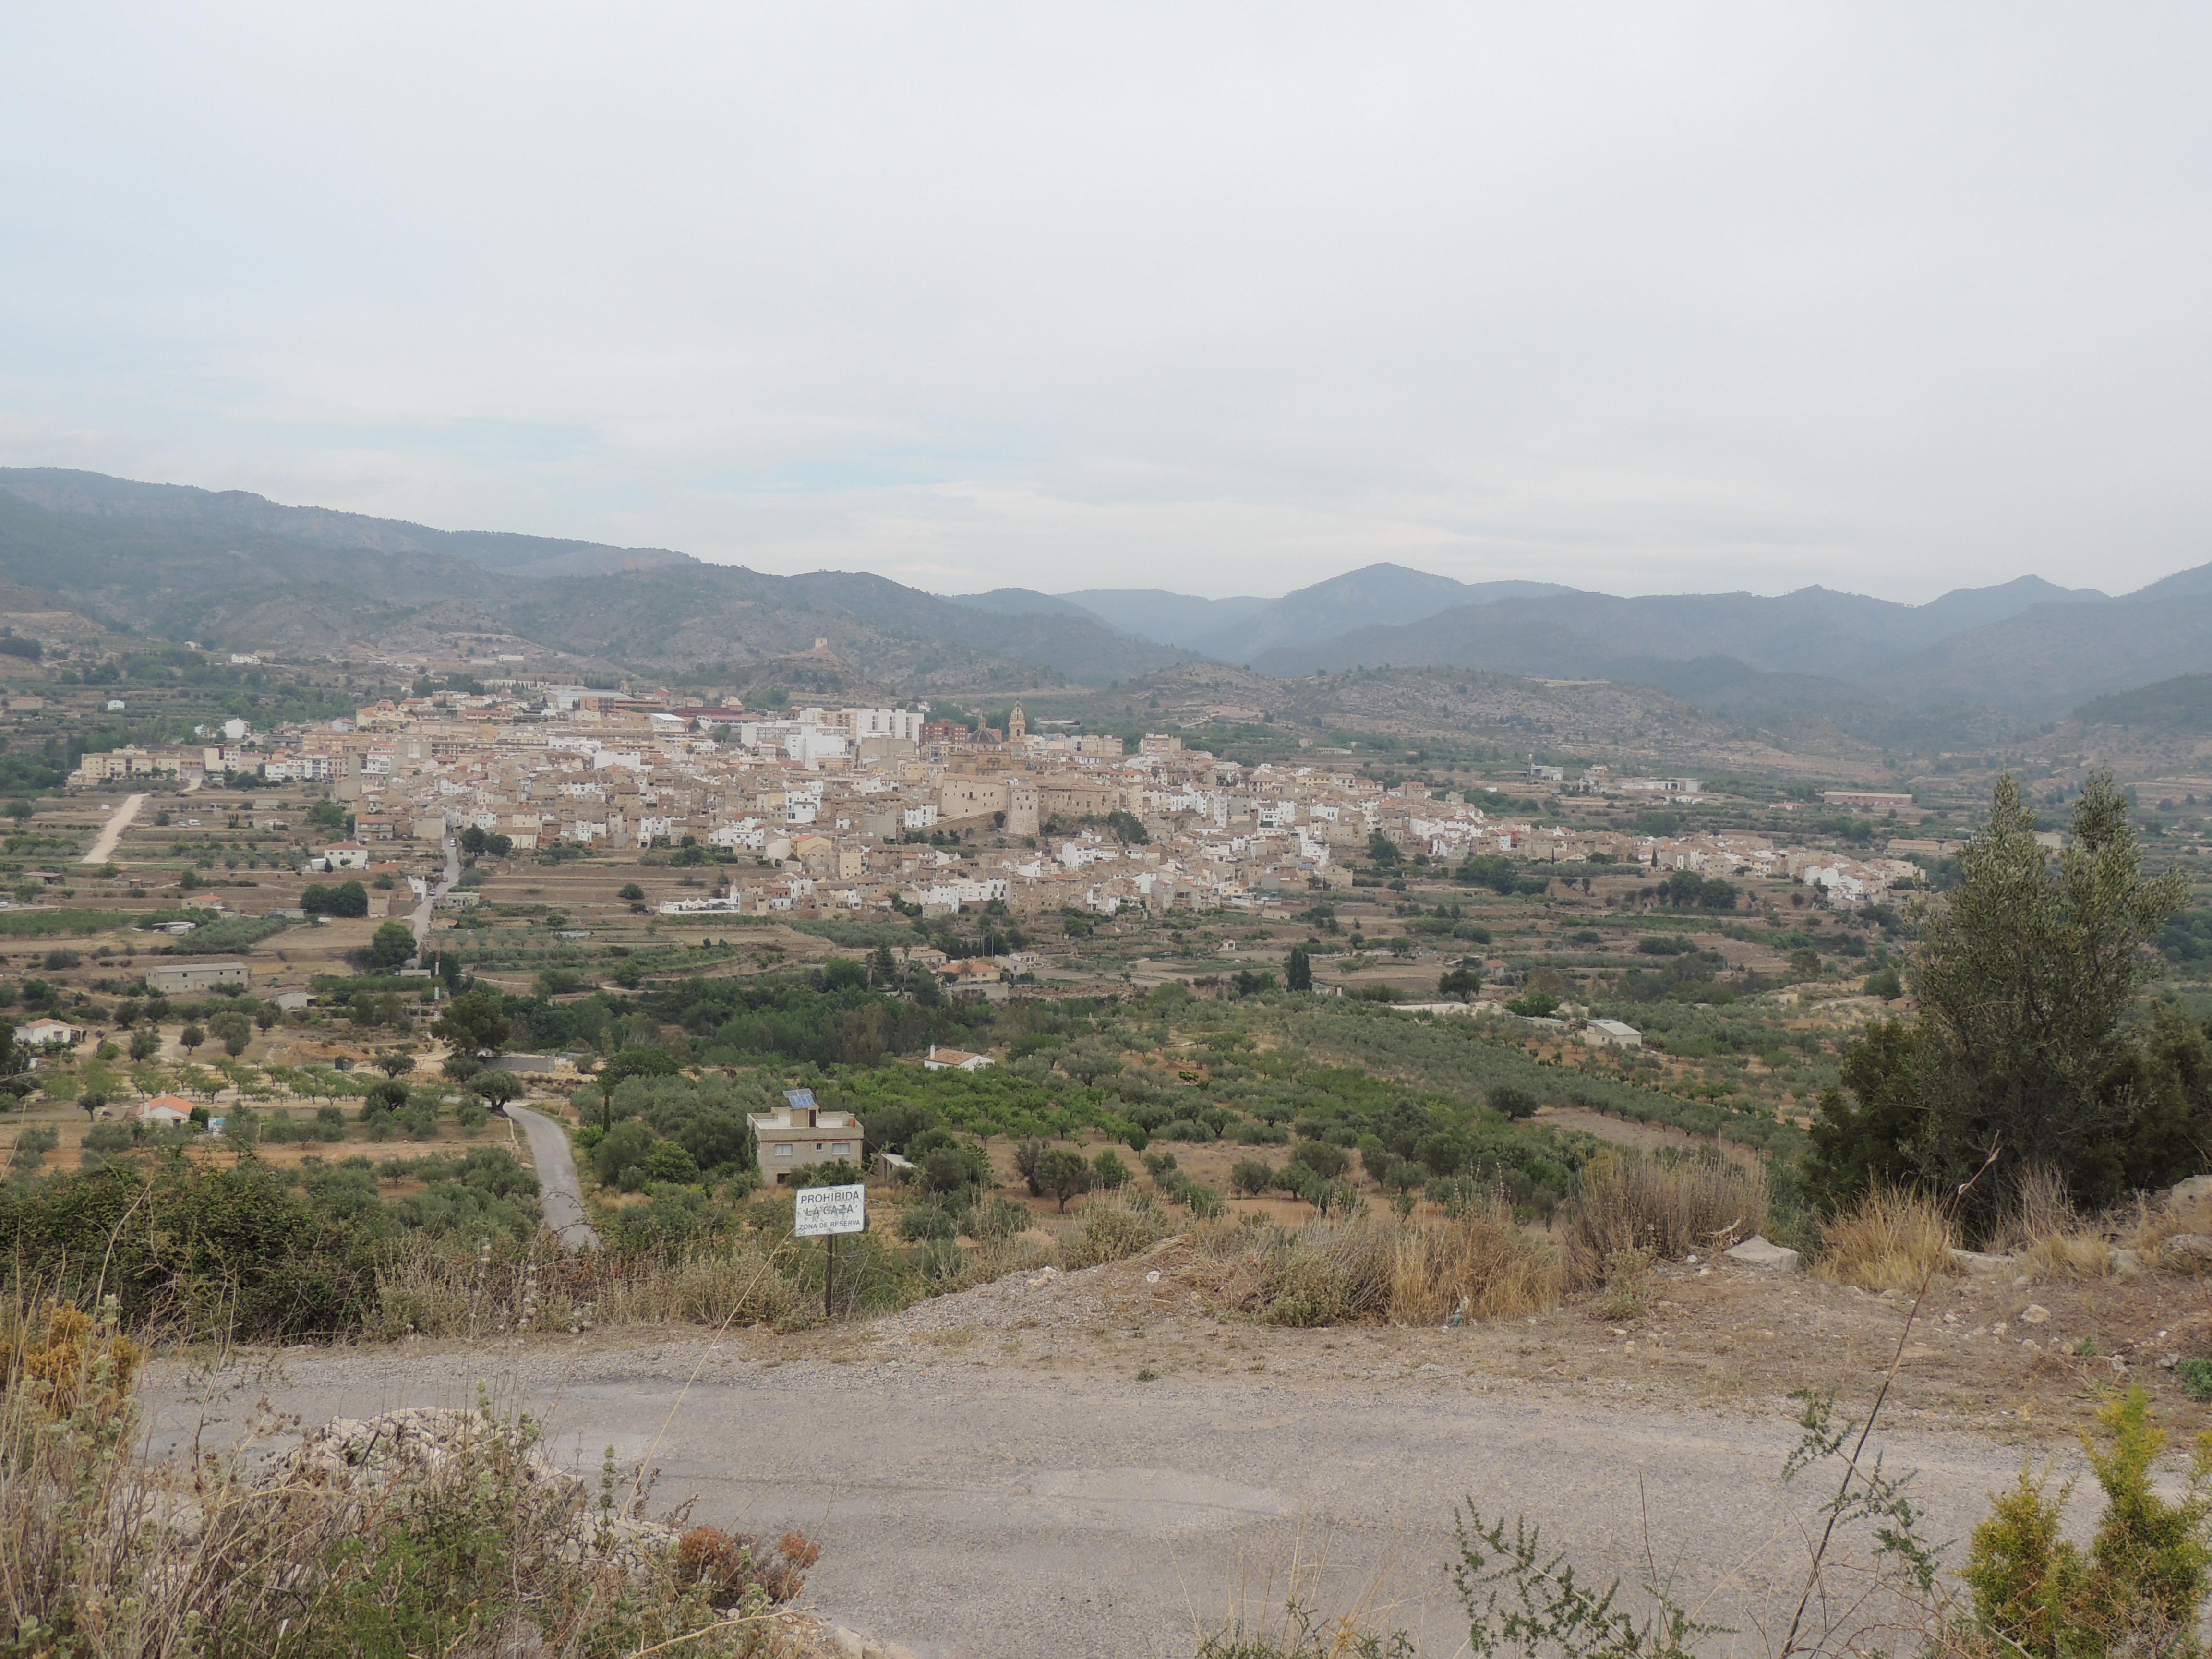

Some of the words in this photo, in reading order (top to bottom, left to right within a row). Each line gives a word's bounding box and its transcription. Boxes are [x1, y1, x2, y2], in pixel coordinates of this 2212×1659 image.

[801, 1191, 859, 1204] PROHIBIDA
[805, 1207, 819, 1216] LA
[823, 1204, 854, 1215] CAZA
